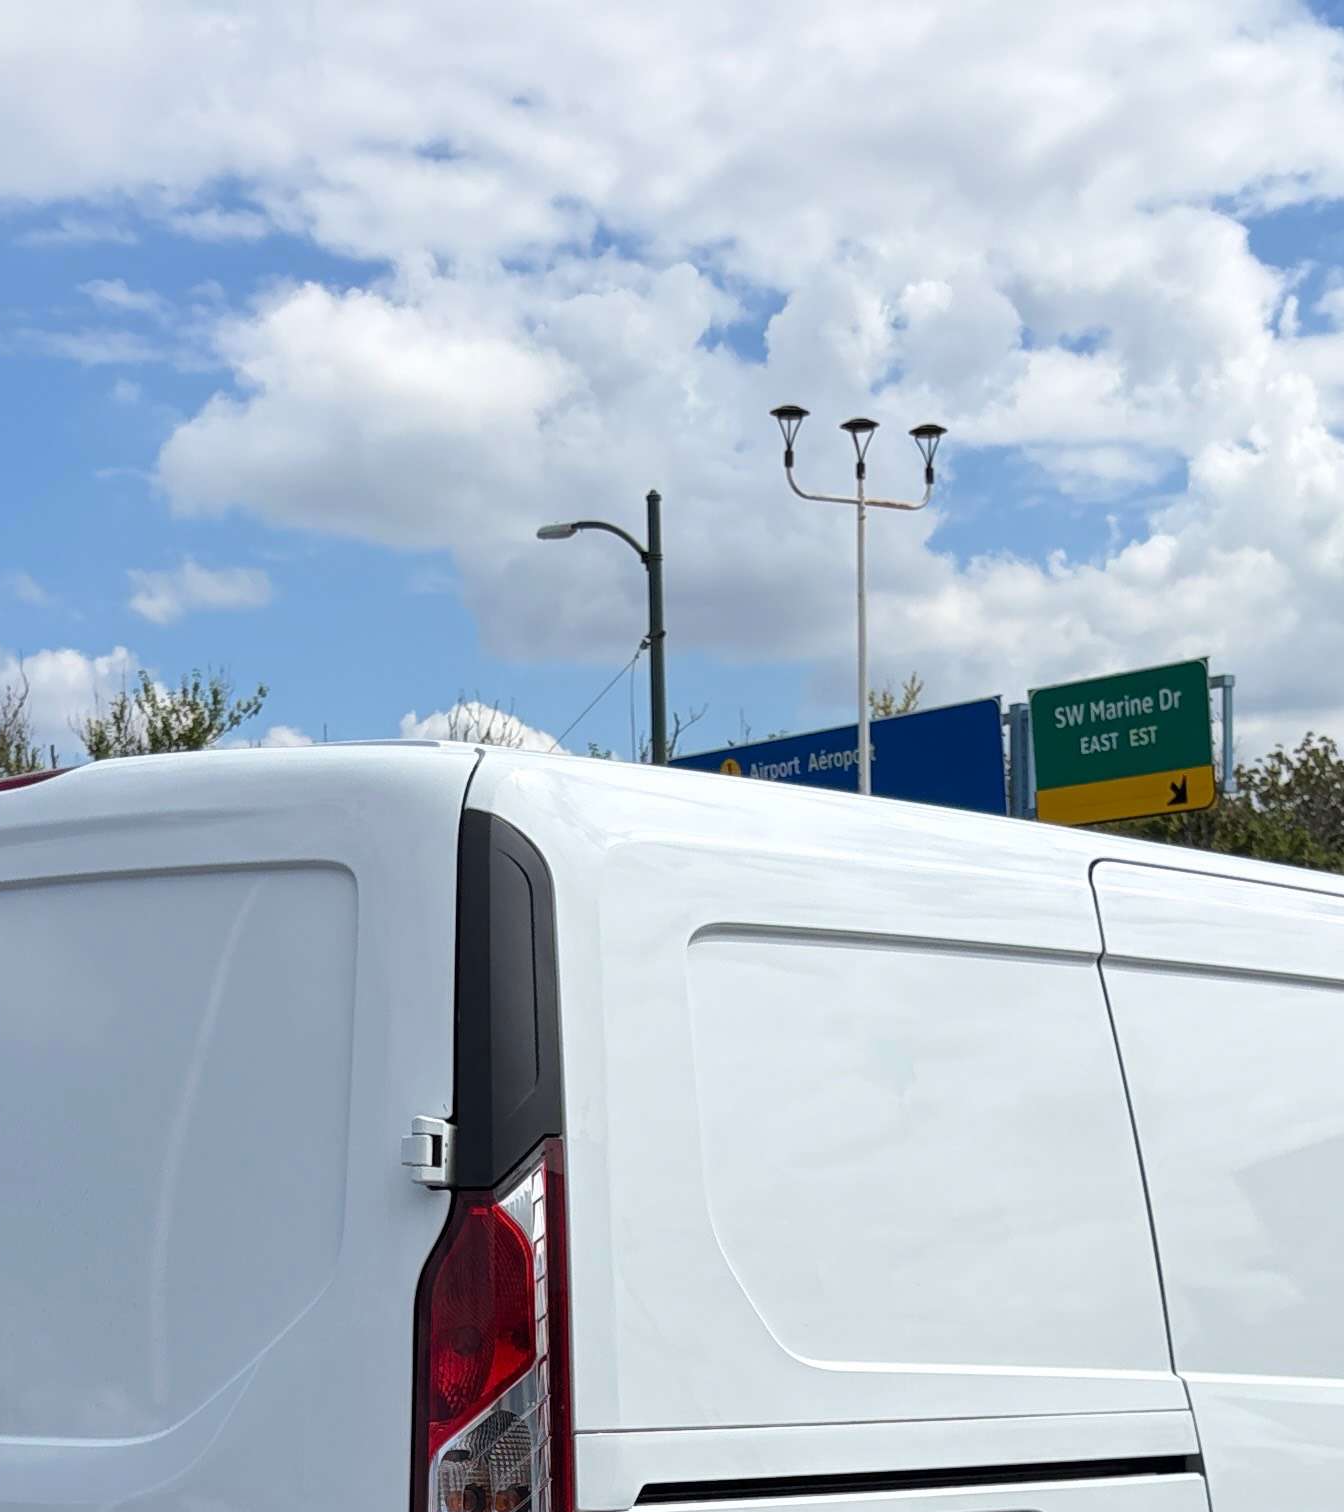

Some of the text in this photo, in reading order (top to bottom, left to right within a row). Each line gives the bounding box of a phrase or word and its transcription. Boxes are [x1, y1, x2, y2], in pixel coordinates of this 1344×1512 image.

[1054, 688, 1182, 729] SW Marine Dr
[1080, 725, 1158, 755] EAST EST
[749, 744, 876, 780] Airport Aéropot
